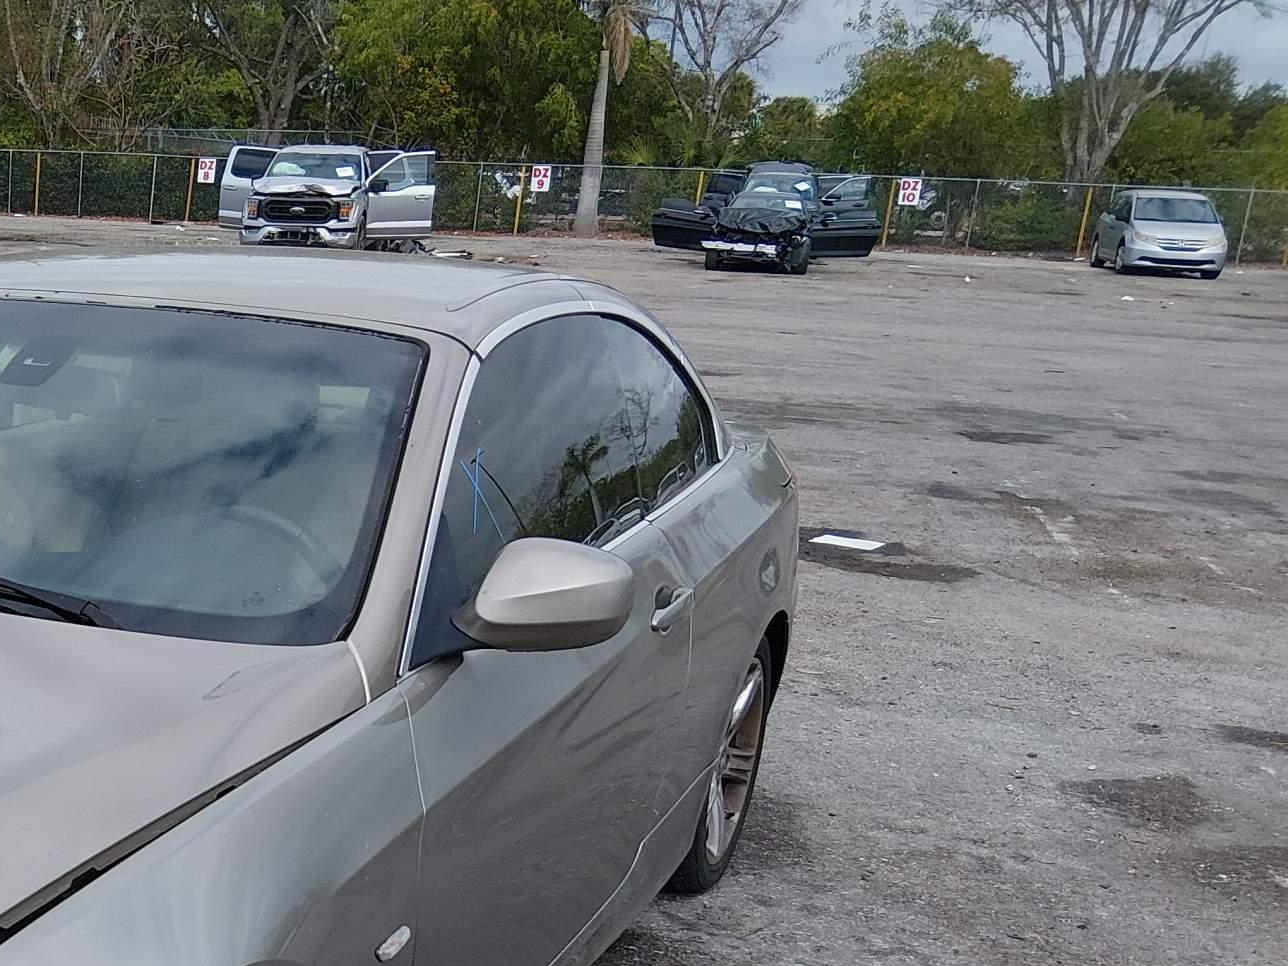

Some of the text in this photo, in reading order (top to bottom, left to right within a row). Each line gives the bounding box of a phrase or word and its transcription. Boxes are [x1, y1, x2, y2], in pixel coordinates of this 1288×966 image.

[200, 160, 215, 170] DZ
[203, 171, 210, 181] 8
[533, 168, 550, 178] DZ
[536, 179, 545, 189] 9
[901, 180, 920, 191] DZ
[901, 192, 915, 203] 10
